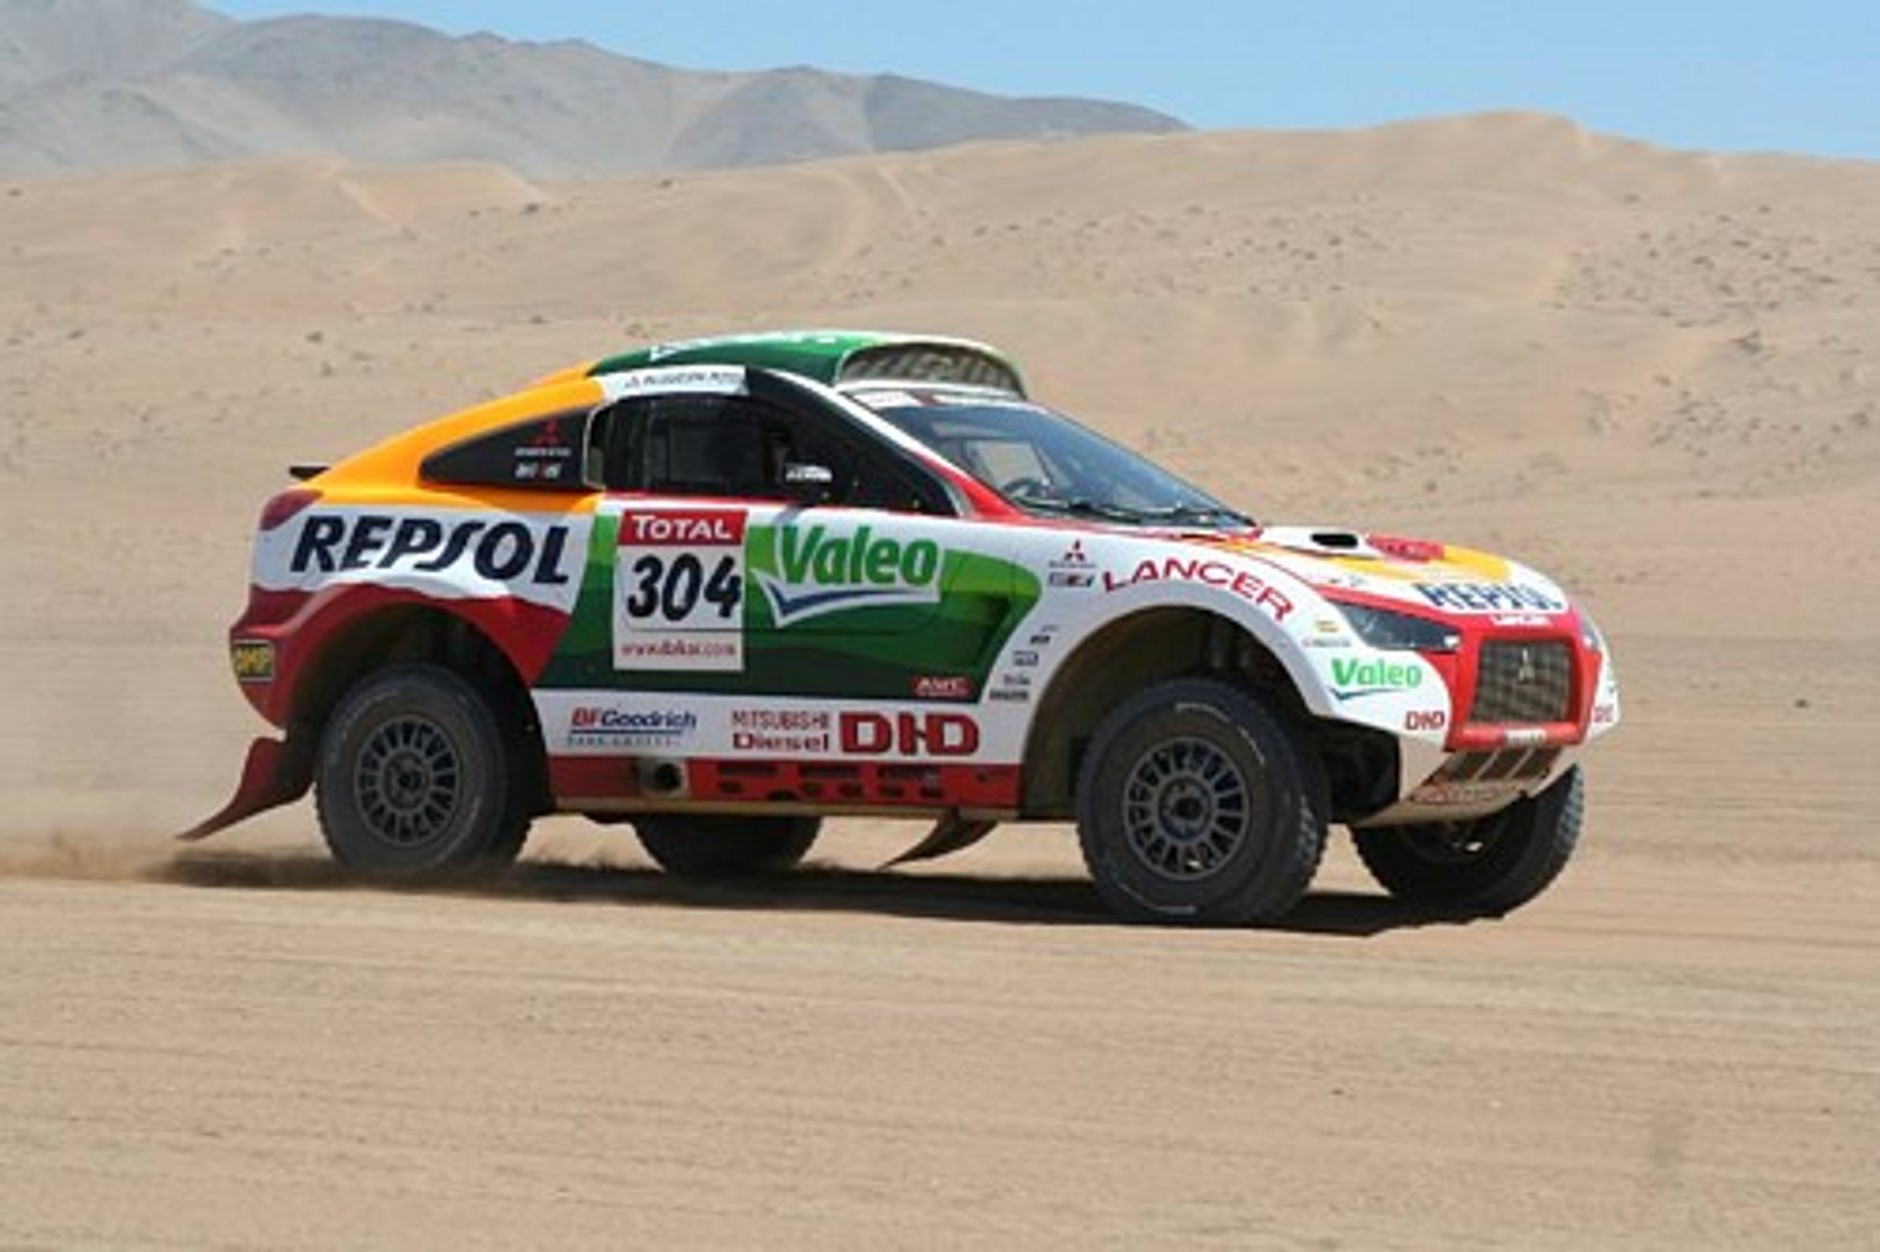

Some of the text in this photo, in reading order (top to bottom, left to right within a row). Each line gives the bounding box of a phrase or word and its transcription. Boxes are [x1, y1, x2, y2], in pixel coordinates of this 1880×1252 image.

[631, 514, 732, 540] TOTAL
[290, 514, 569, 584] REPSOL
[781, 525, 939, 585] Valeo
[626, 553, 742, 622] 304
[1102, 558, 1295, 622] LANCER
[1331, 658, 1422, 687] Valeo
[570, 707, 697, 729] BFGoodrich
[732, 711, 830, 729] MITSUBISHI
[732, 733, 829, 750] Diesel
